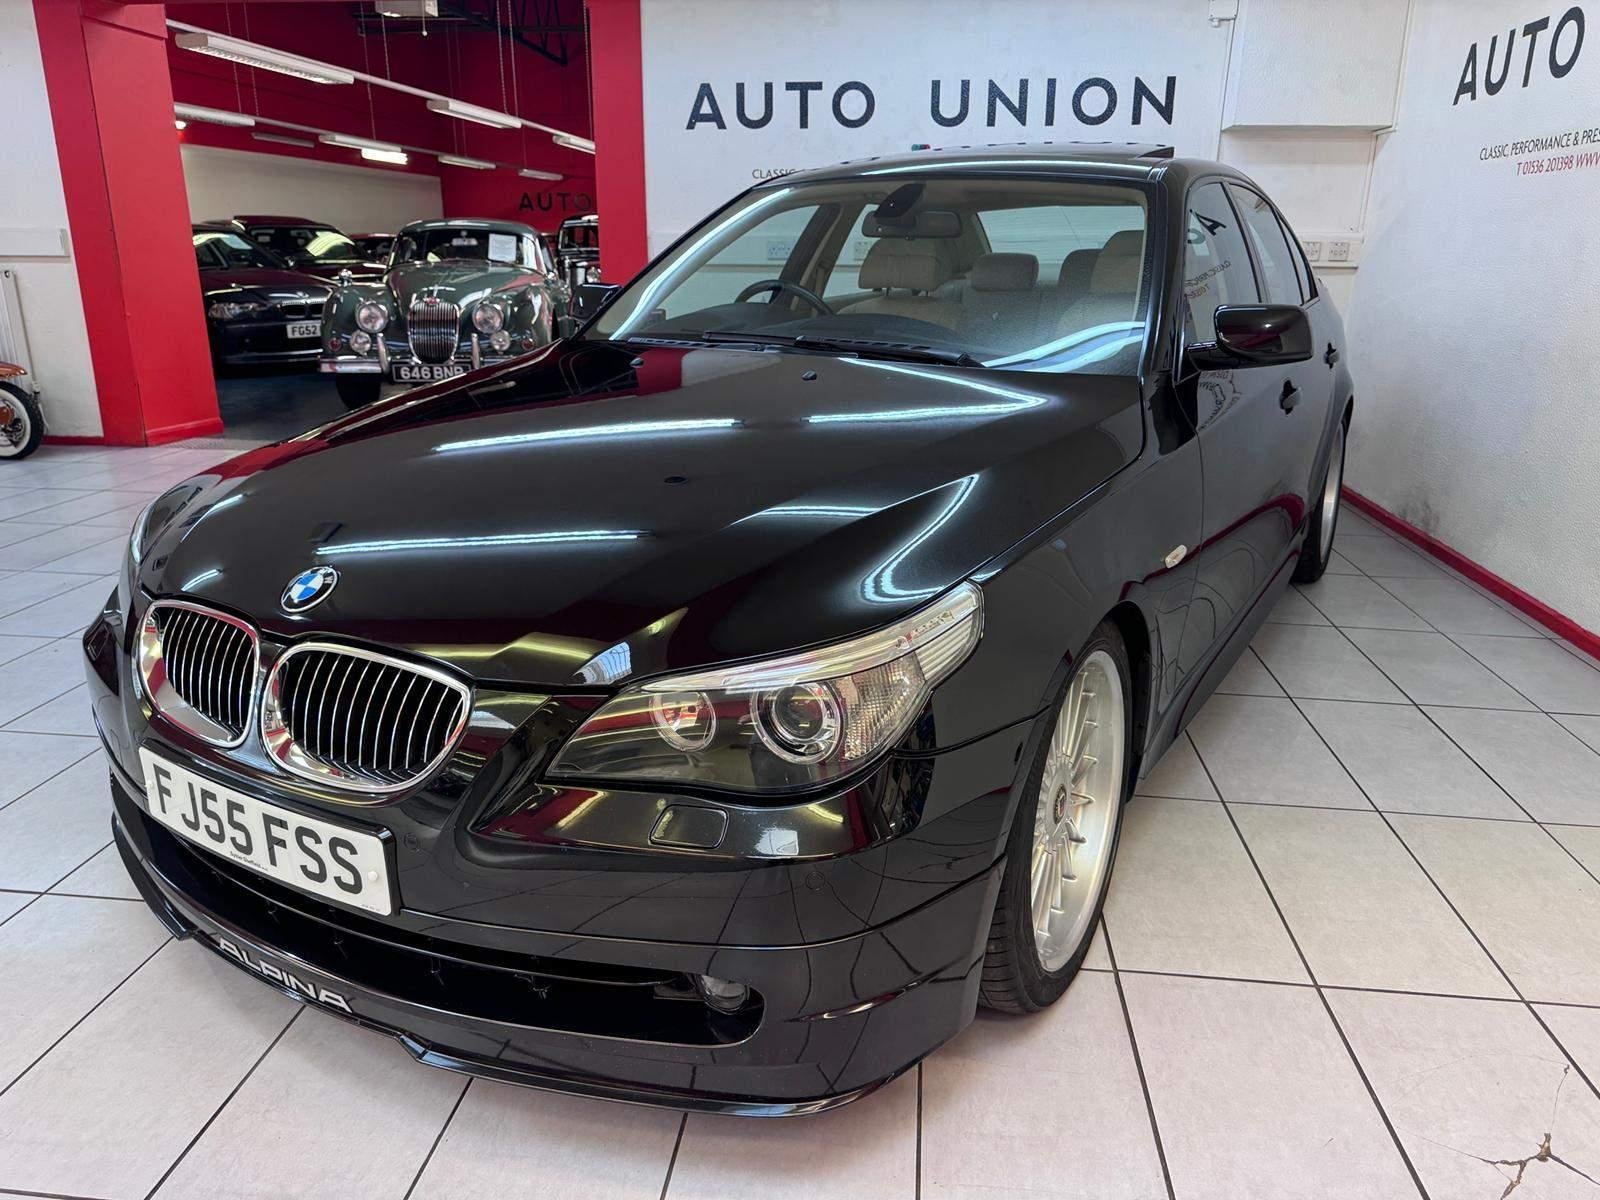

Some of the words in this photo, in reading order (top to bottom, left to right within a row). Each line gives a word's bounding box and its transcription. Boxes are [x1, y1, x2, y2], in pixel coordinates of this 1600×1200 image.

[1453, 6, 1585, 106] AUTO
[686, 80, 876, 129] AUTO
[930, 76, 1177, 127] UNION
[1510, 132, 1572, 156] PERFORMANCE
[1573, 131, 1580, 146] &
[1517, 162, 1523, 176] T
[1523, 160, 1545, 175] 01536
[1545, 155, 1574, 173] 201398
[519, 192, 592, 212] AUTO
[291, 325, 318, 336] FG52
[400, 366, 431, 379] 646
[153, 762, 254, 857] FJ55
[262, 811, 363, 895] FSS
[219, 936, 353, 1014] ALPINA
